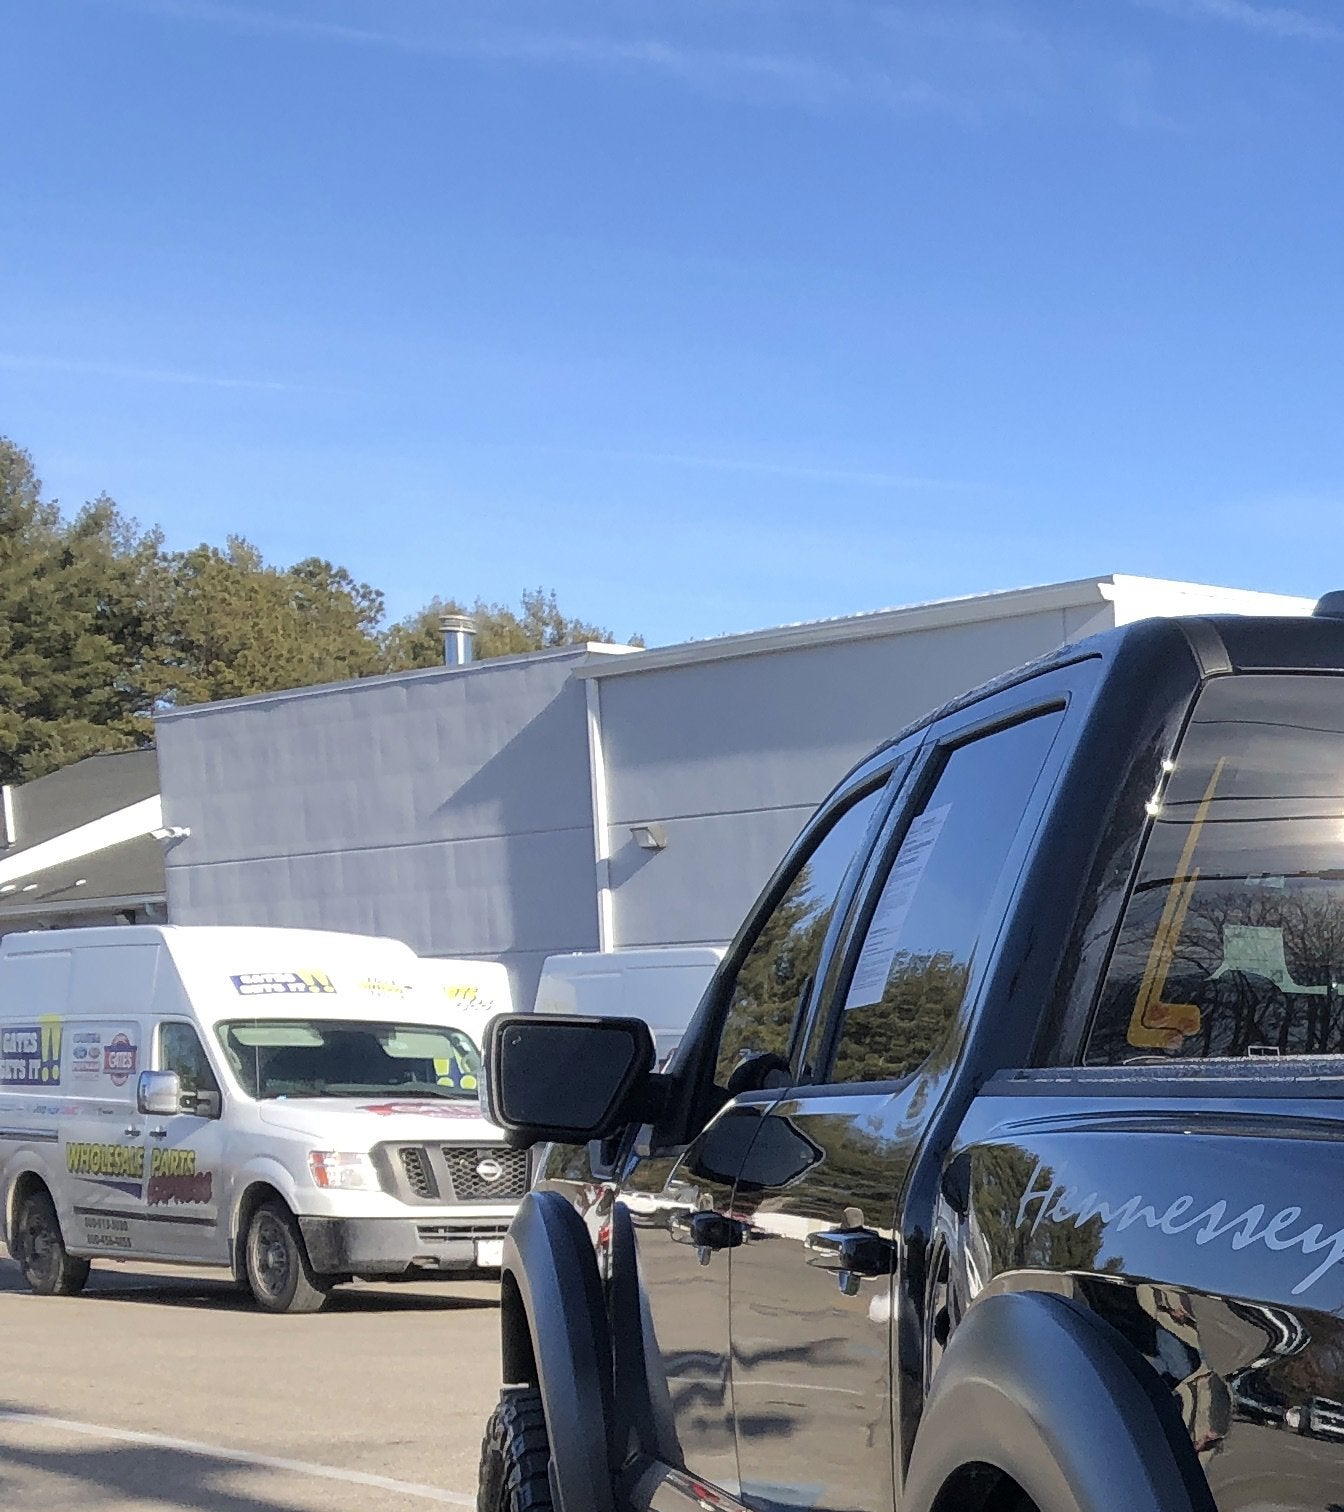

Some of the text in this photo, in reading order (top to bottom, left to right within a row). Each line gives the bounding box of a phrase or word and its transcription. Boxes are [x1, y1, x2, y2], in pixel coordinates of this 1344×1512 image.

[3, 1031, 38, 1054] GATES
[108, 1050, 133, 1069] GATES
[66, 1142, 196, 1178] WHOLESALE PARTS
